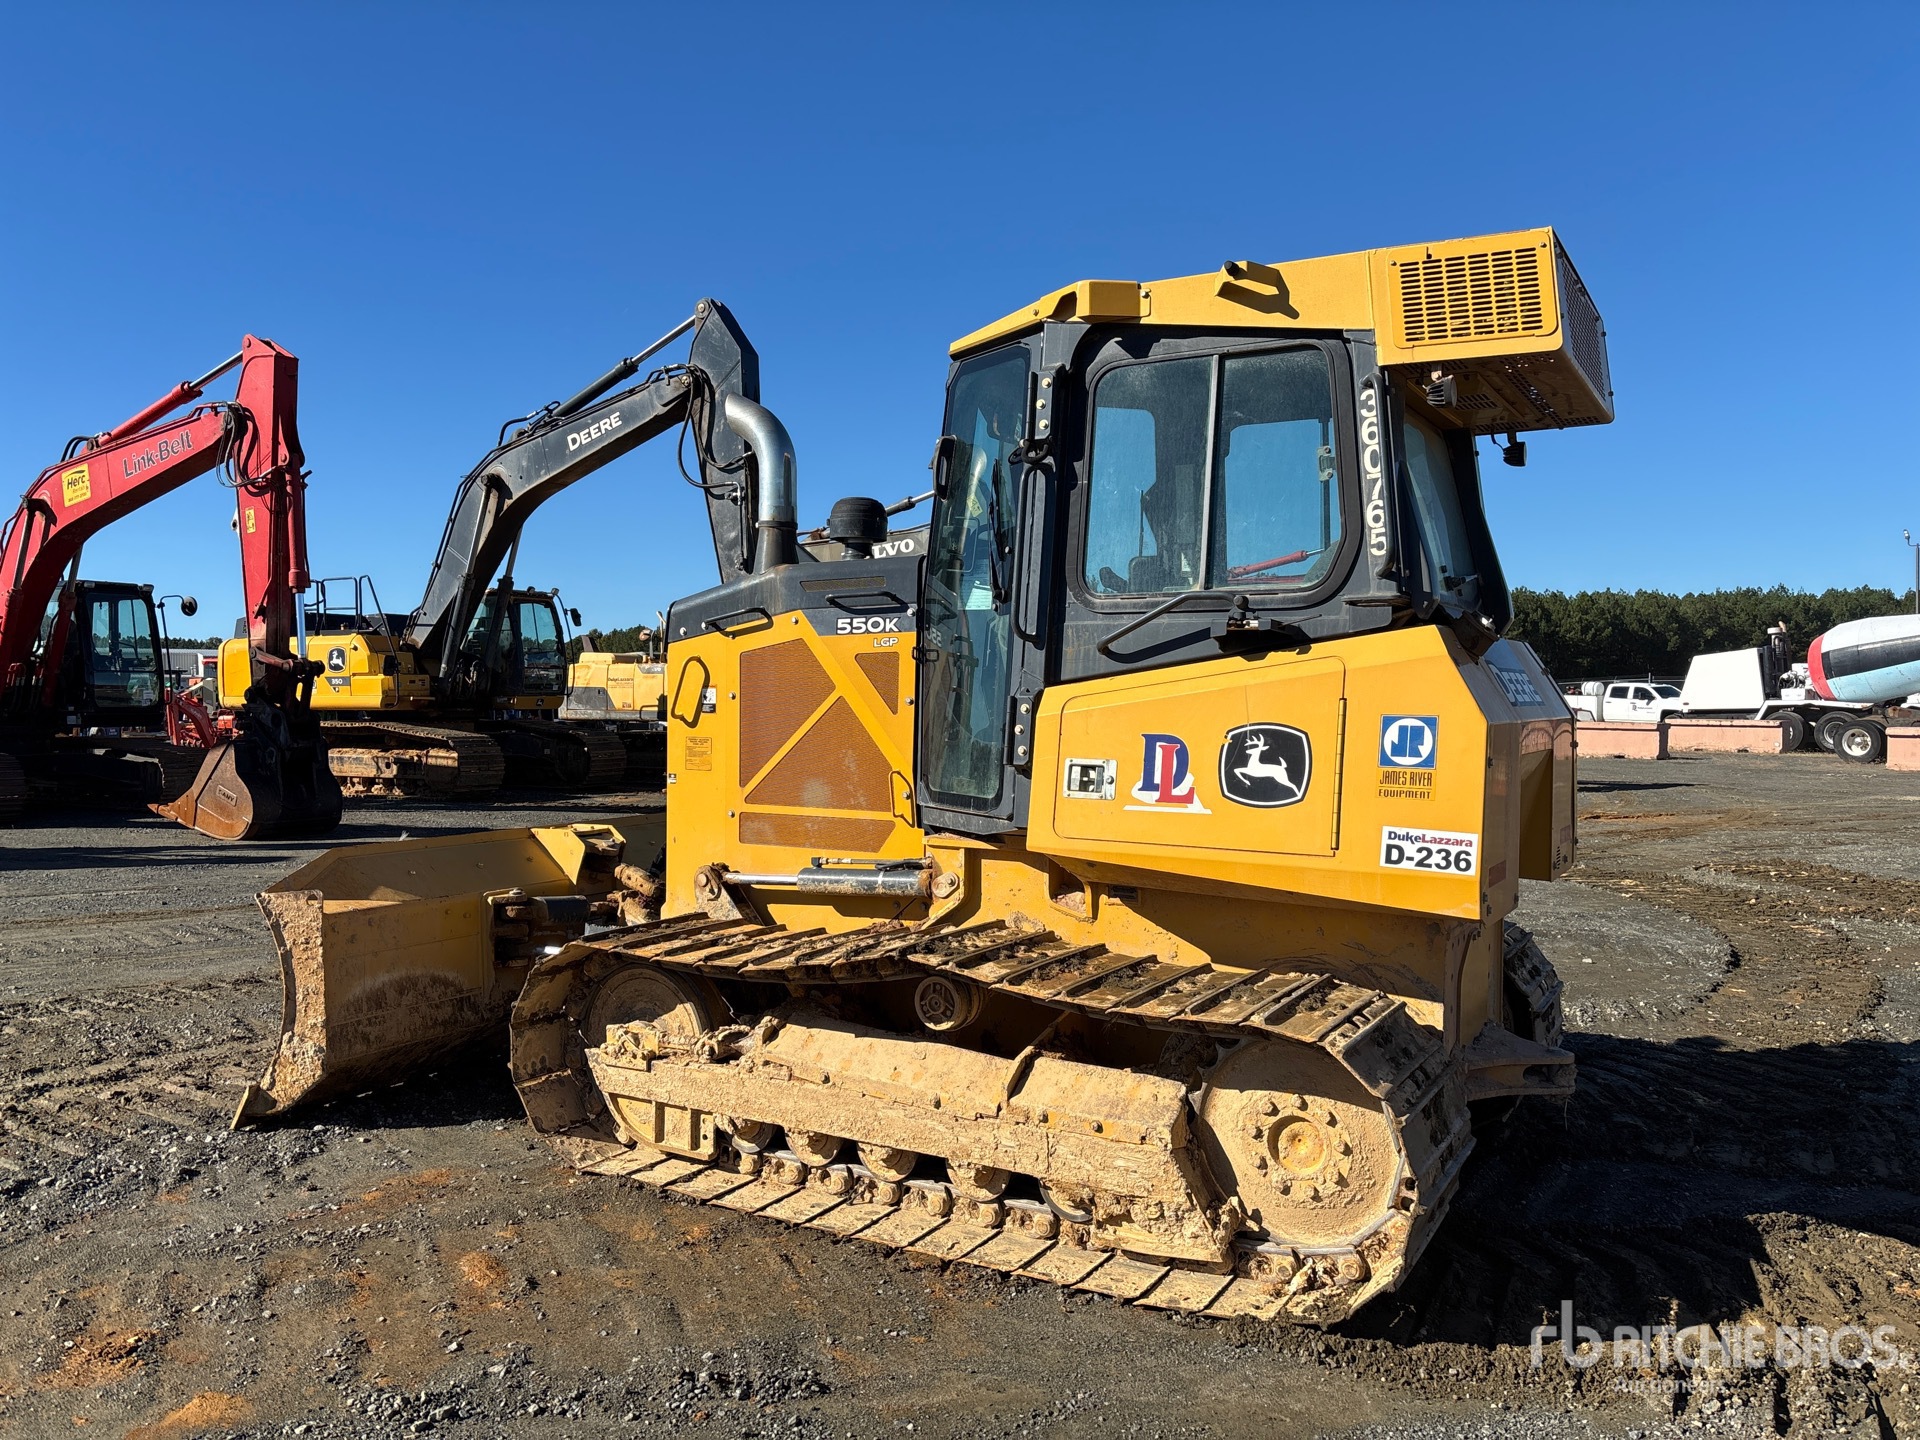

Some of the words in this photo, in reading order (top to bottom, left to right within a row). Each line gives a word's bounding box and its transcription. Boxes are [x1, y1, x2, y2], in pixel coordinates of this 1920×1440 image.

[566, 411, 622, 451] DEERE
[122, 429, 192, 478] Link-Belt
[67, 474, 86, 490] Herc
[1360, 388, 1387, 556] 360765
[836, 616, 900, 634] 550K
[873, 637, 899, 647] LGP
[1488, 663, 1542, 702] DEERE
[1390, 725, 1425, 758] JR
[1138, 733, 1195, 804] DL
[1379, 770, 1407, 786] JAMES
[1409, 771, 1433, 787] RIVER
[1378, 788, 1431, 799] EQUIPMENT
[1387, 830, 1473, 847] DukeLazzara
[1384, 843, 1472, 872] D-236
